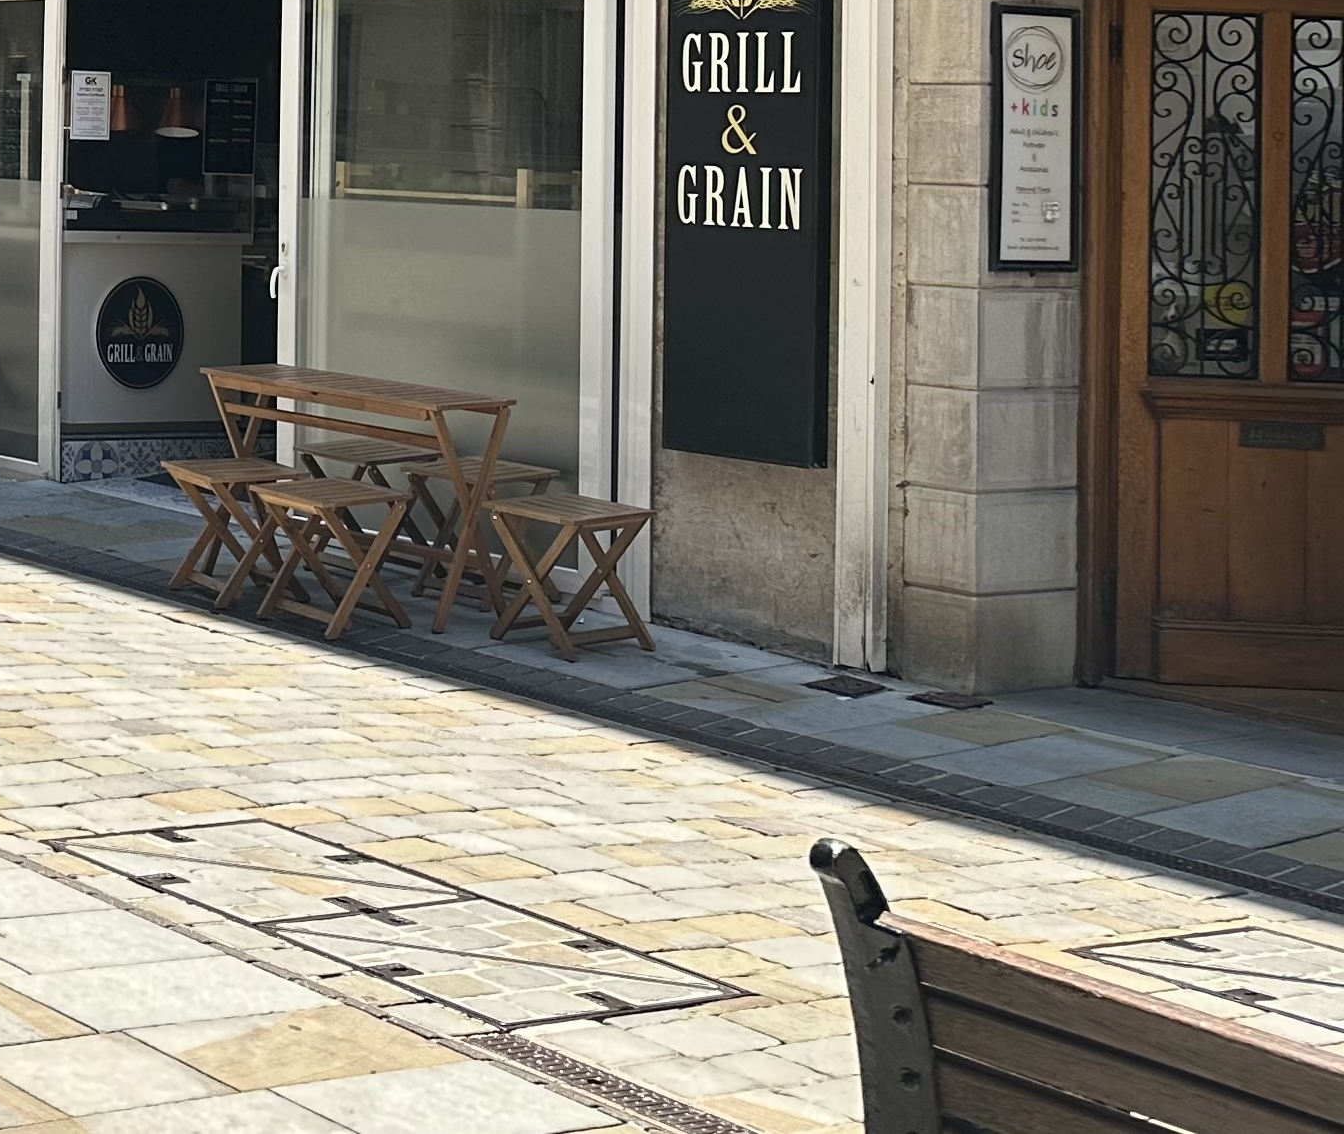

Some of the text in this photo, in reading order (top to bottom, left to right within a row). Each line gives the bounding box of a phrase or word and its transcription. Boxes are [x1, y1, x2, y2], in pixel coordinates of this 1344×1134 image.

[682, 32, 801, 92] GRILL
[721, 105, 757, 154] &
[677, 164, 803, 230] GRAIN
[107, 343, 135, 363] GRILL
[144, 343, 173, 363] GRAIN
